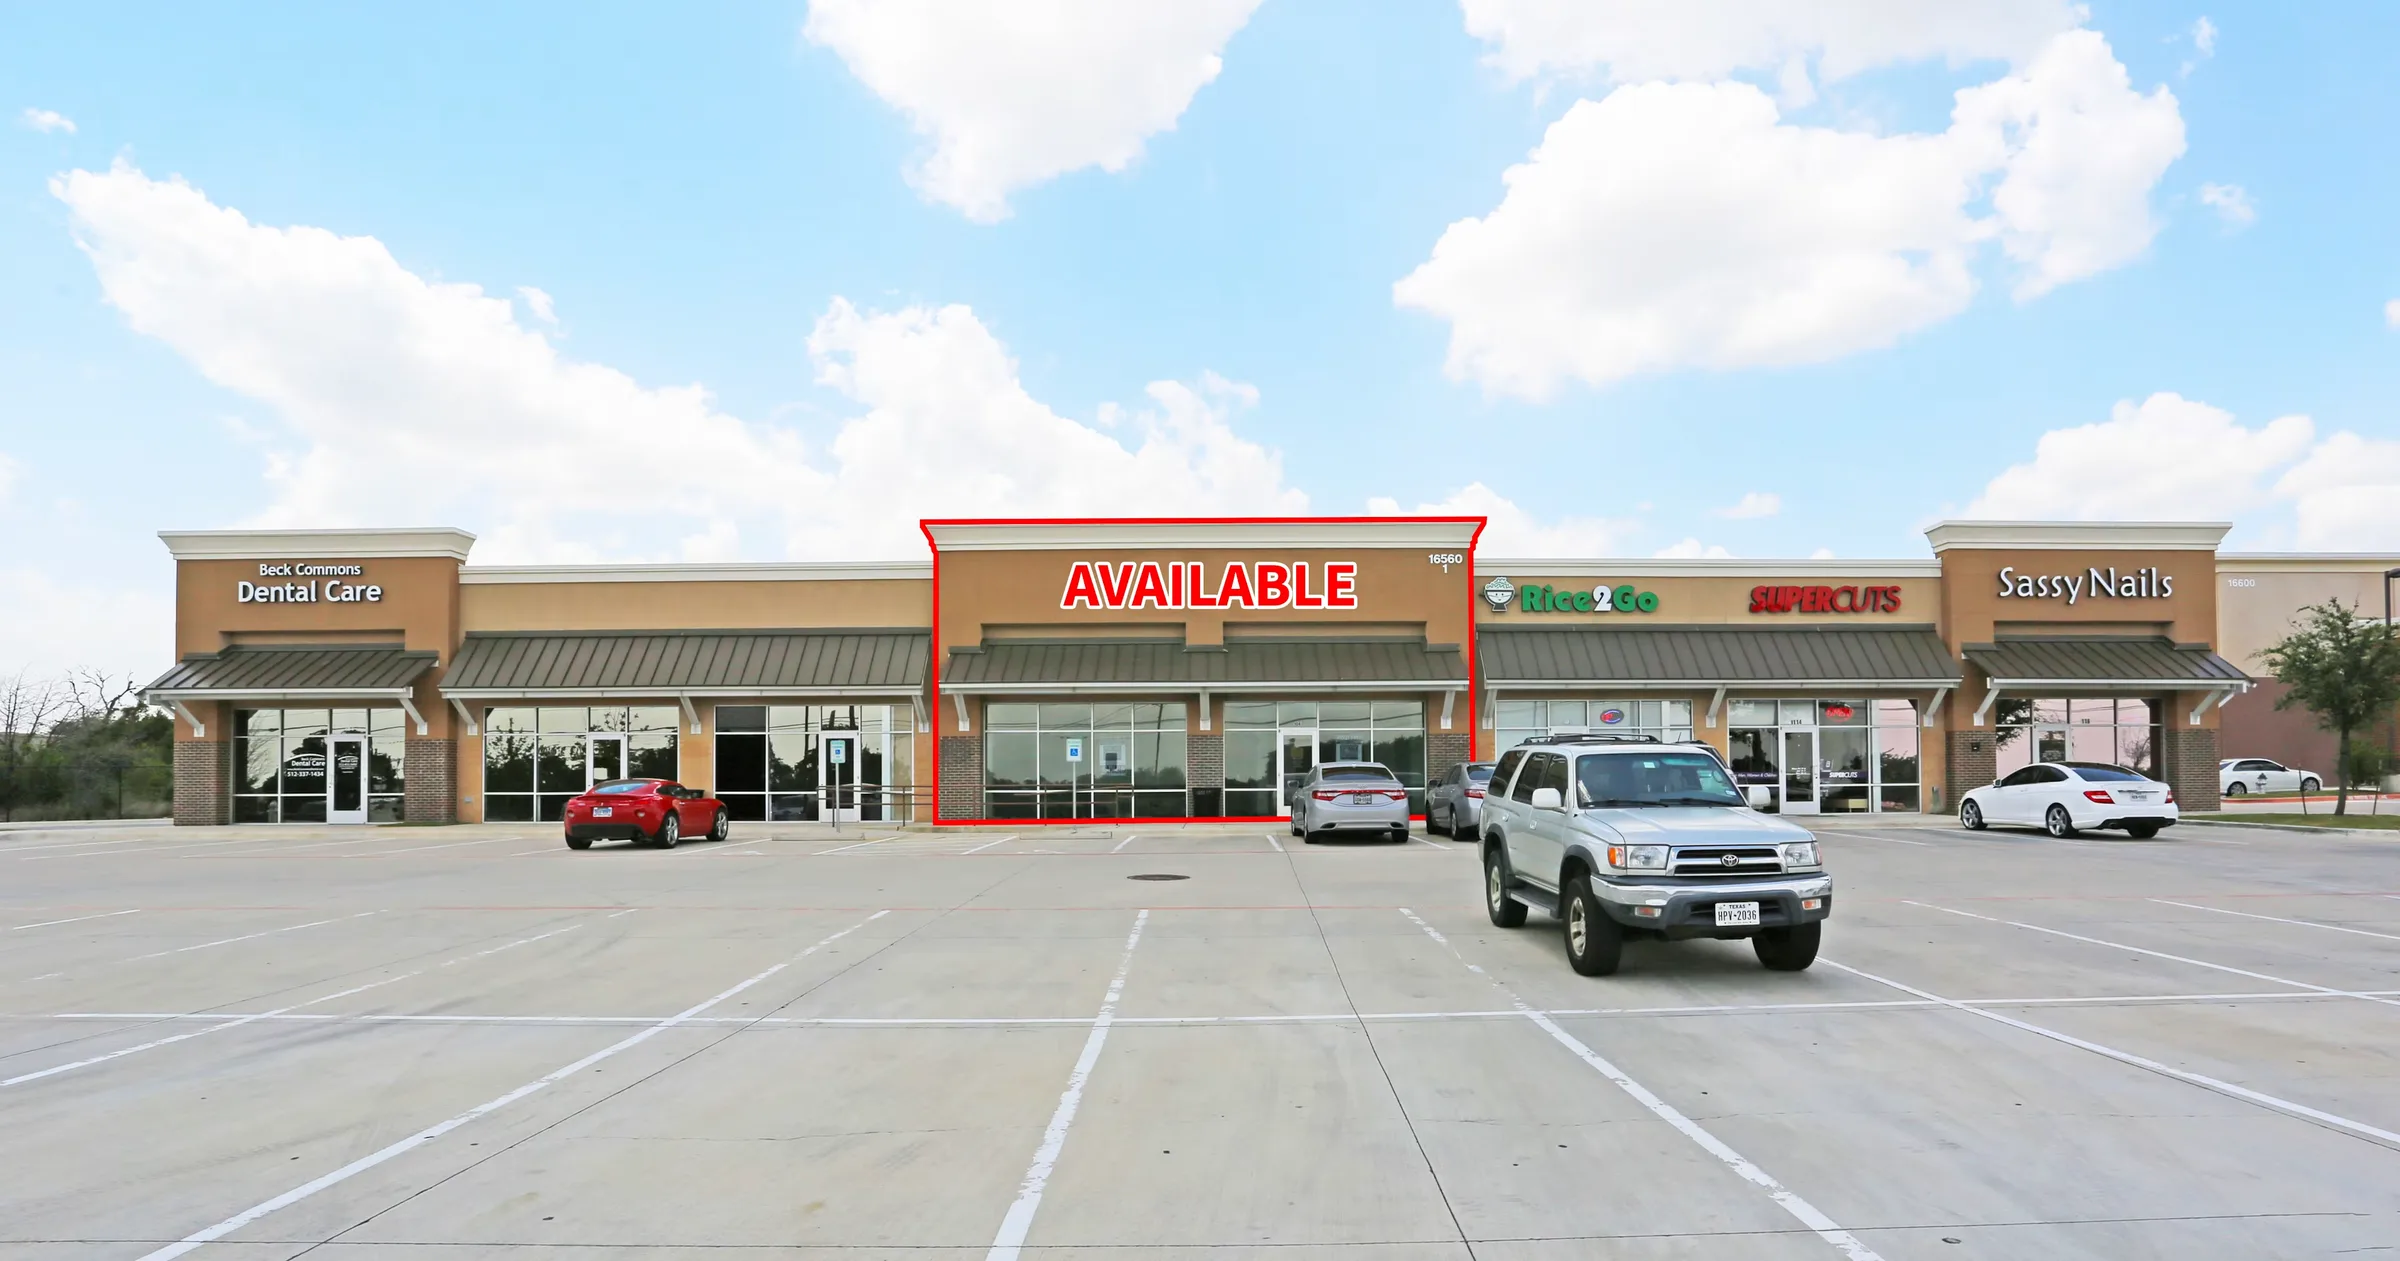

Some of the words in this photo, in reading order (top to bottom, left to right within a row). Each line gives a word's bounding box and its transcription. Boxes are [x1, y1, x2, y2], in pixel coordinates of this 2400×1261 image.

[259, 563, 292, 576] Beck
[295, 563, 361, 576] Commons
[1428, 553, 1463, 564] 16560
[237, 580, 317, 603] Dental
[324, 580, 382, 602] Care
[1999, 566, 2083, 605] Sassy
[2089, 566, 2173, 598] Nails
[2227, 578, 2256, 588] 16600
[1520, 584, 1660, 612] Rice2Go
[1750, 585, 1902, 613] SUPERCUTS
